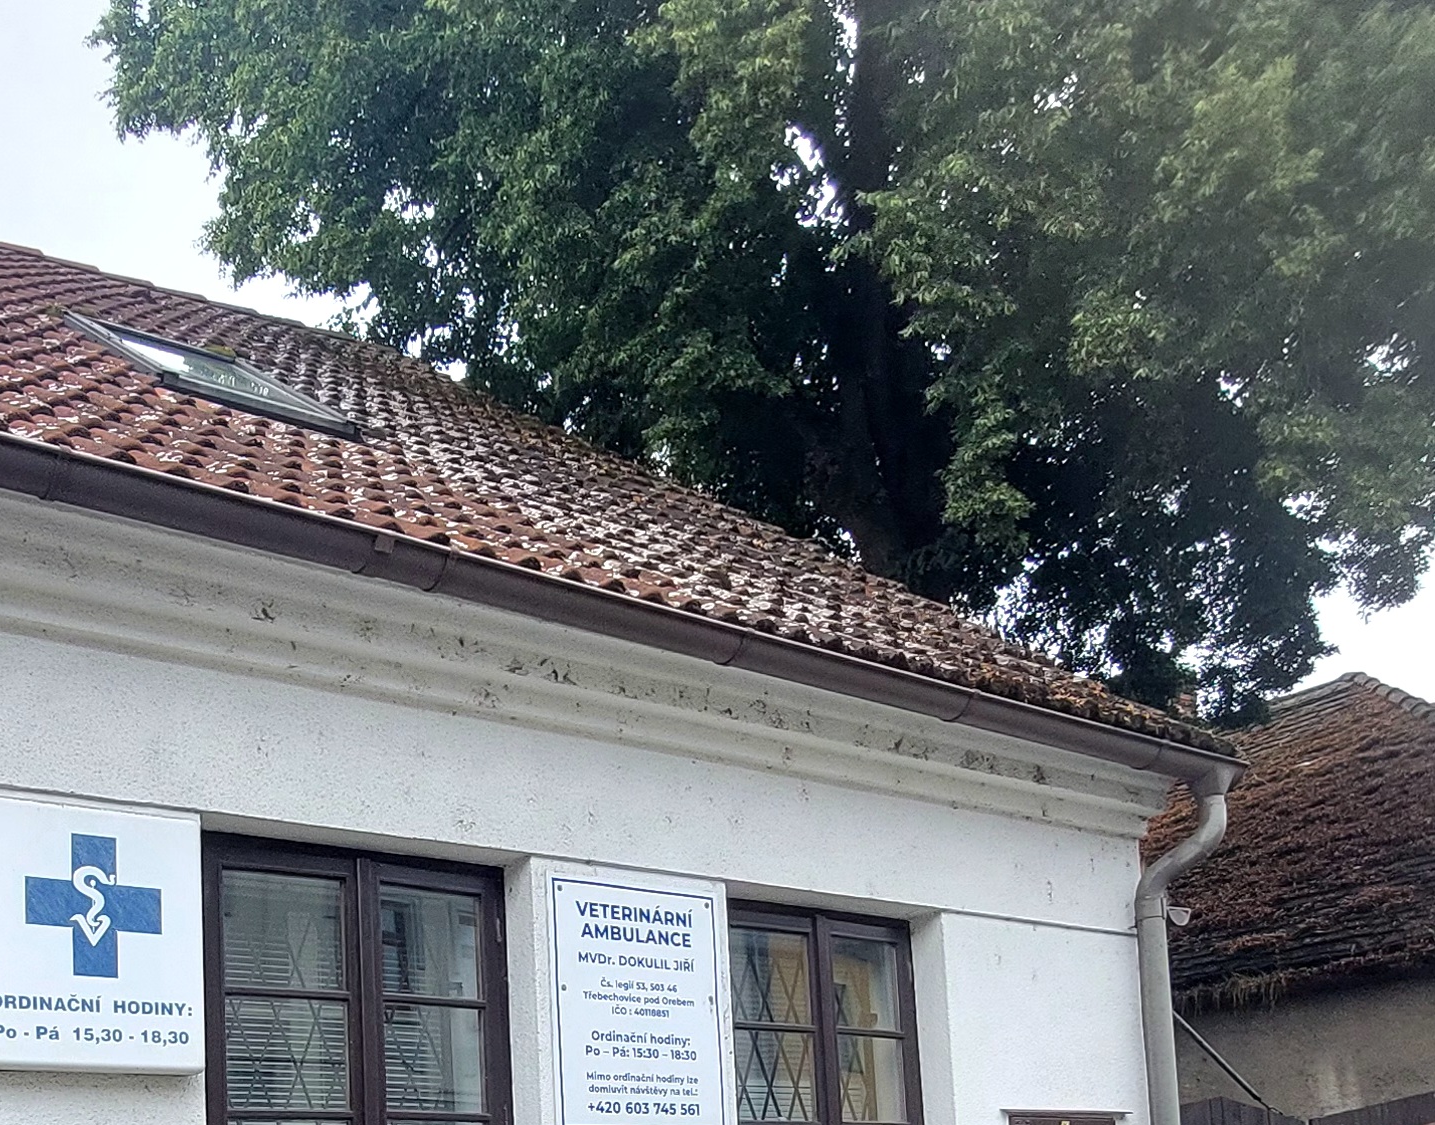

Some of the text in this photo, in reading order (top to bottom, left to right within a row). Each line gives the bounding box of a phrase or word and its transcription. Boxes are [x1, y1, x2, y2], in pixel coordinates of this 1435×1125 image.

[575, 900, 693, 928] VETERINÁRNÍ
[581, 922, 692, 948] AMBULANCE
[578, 951, 695, 972] MVDr. DOKULIL JIŘÍ
[636, 982, 648, 992] 53,
[650, 983, 665, 992] 503
[666, 985, 678, 993] 46
[583, 991, 695, 1007] Třebechovice pod Orebem
[113, 1000, 193, 1017] HODINY:
[611, 1004, 627, 1015] IČO
[35, 1026, 60, 1041] Pá
[72, 1027, 123, 1045] 15,30
[140, 1030, 190, 1047] 18,30
[591, 1030, 691, 1049] Ordinační hodiny:
[585, 1045, 600, 1056] Po
[612, 1046, 630, 1058] Pá:
[632, 1047, 659, 1059] 15:30
[670, 1049, 697, 1061] 18:30
[586, 1071, 699, 1086] Mimo ordinační hodiny lze
[588, 1084, 628, 1094] domluvit
[630, 1085, 668, 1097] návštěvy
[670, 1088, 681, 1096] na
[588, 1101, 700, 1116] +420 603 745 561
